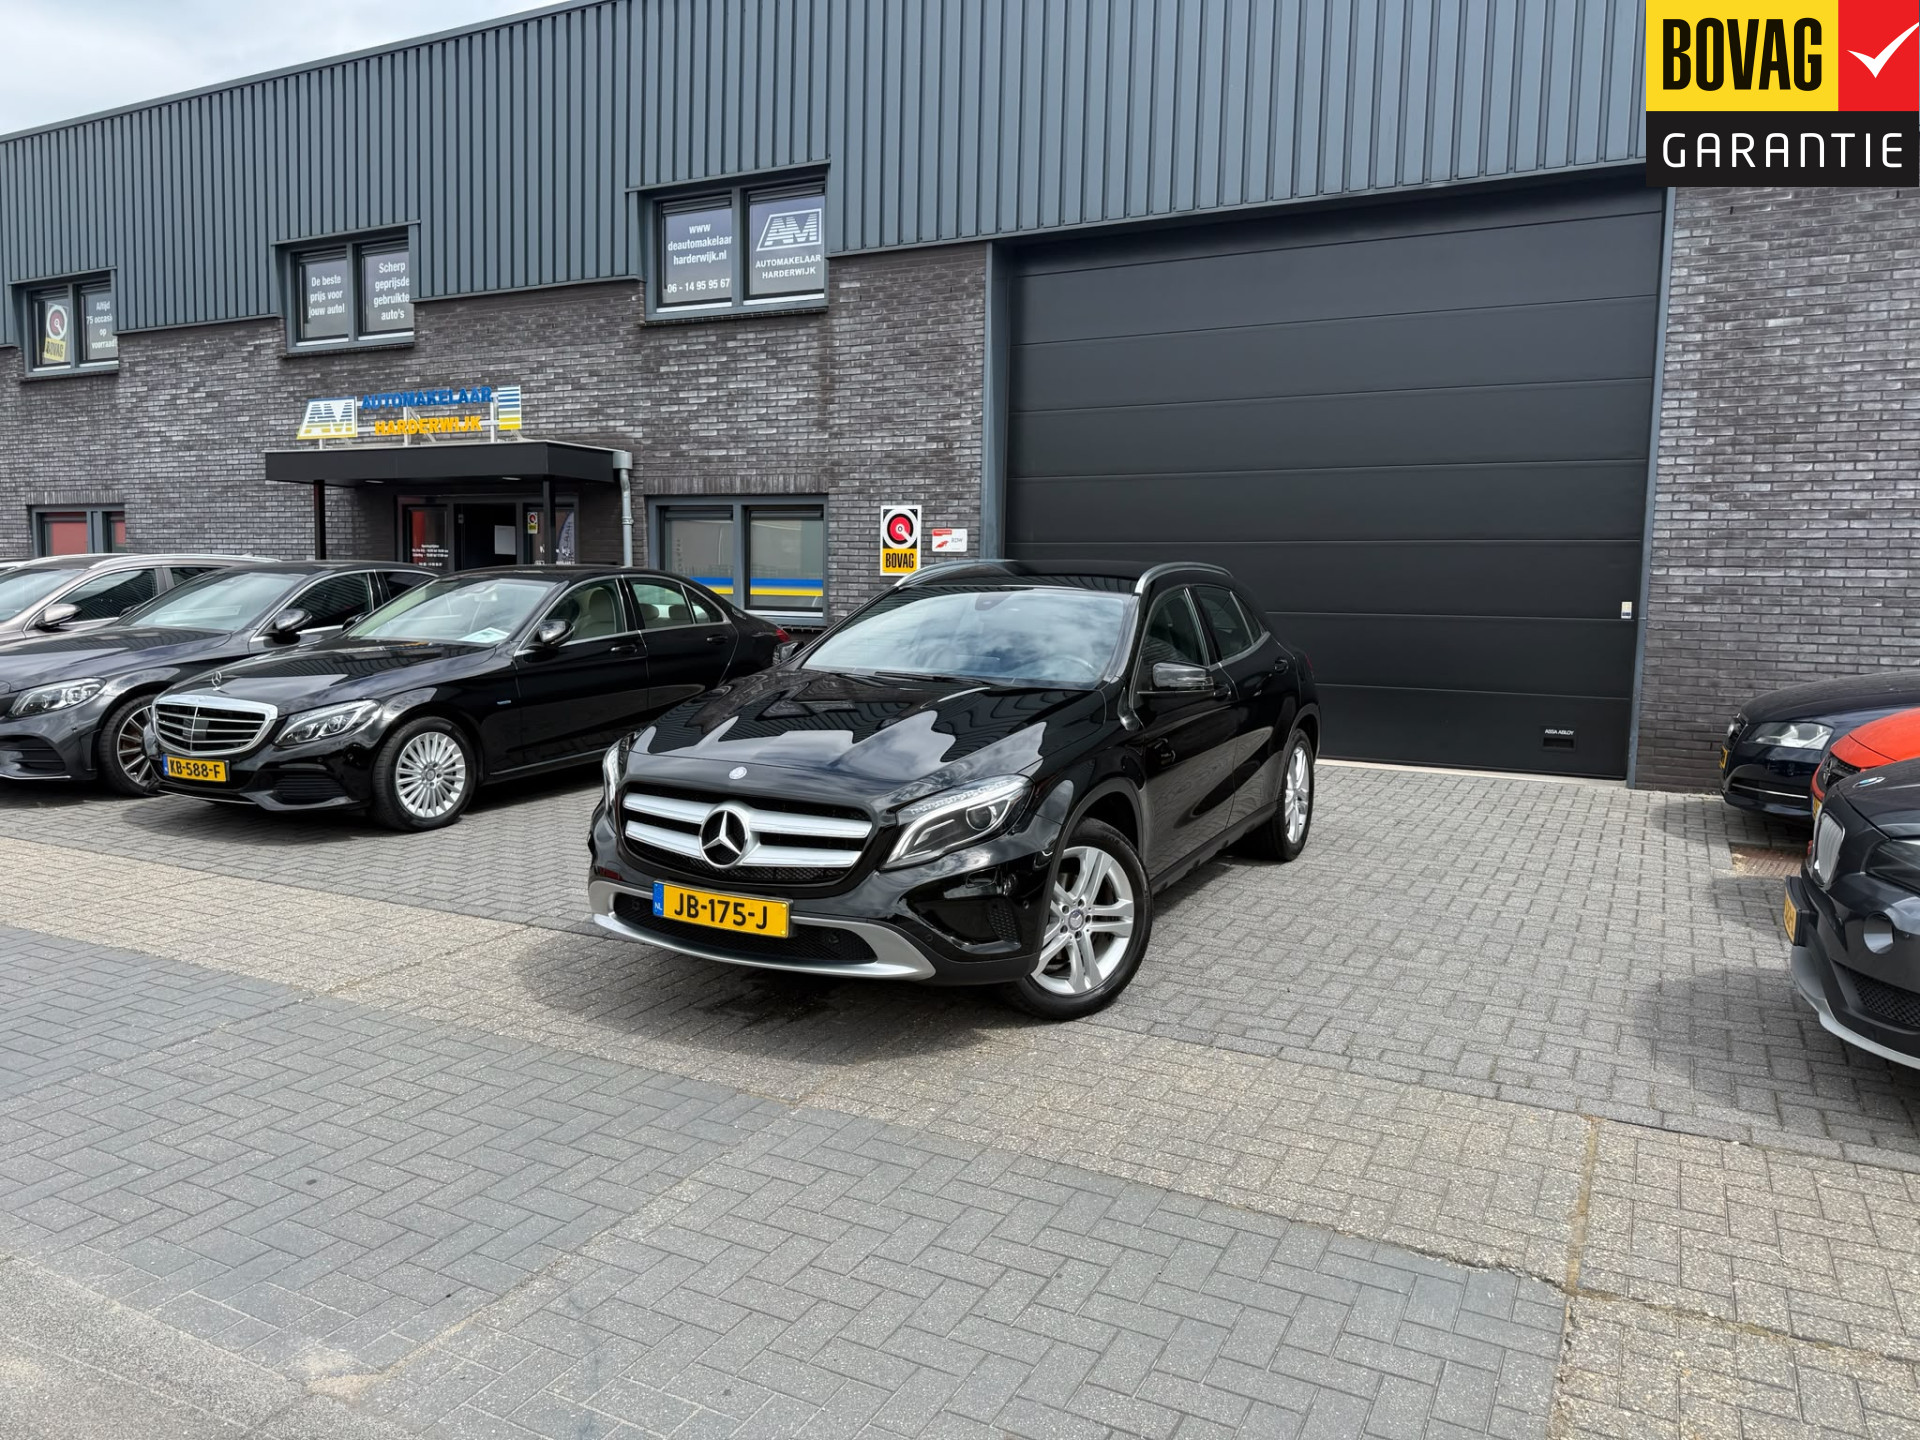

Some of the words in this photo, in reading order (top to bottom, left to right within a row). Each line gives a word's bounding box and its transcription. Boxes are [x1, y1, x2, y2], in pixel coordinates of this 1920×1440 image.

[689, 223, 711, 234] www
[668, 236, 732, 251] deautomakelaar
[673, 250, 727, 265] harderwijk.nl
[755, 254, 821, 268] AUTOMAKELAAR
[379, 262, 406, 273] Scherp
[762, 267, 816, 279] HARDERWIJK
[311, 277, 320, 287] De
[322, 274, 342, 286] beste
[375, 276, 410, 292] geprijsde
[667, 283, 677, 293] 06
[685, 280, 695, 291] 14
[696, 280, 706, 291] 95
[708, 279, 718, 289] 95
[720, 278, 731, 288] 67
[310, 291, 326, 304] prijs
[327, 290, 343, 300] voor
[373, 292, 410, 308] gebruikte
[308, 306, 326, 318] jouw
[327, 303, 345, 315] auto!
[381, 309, 405, 320] auto's
[361, 386, 493, 410] AUTOMAKELAAR
[375, 415, 482, 435] HARDERWIJK
[885, 552, 914, 569] BOVAG
[169, 759, 220, 778] KB-588-F
[674, 893, 768, 930] JB-175-J
